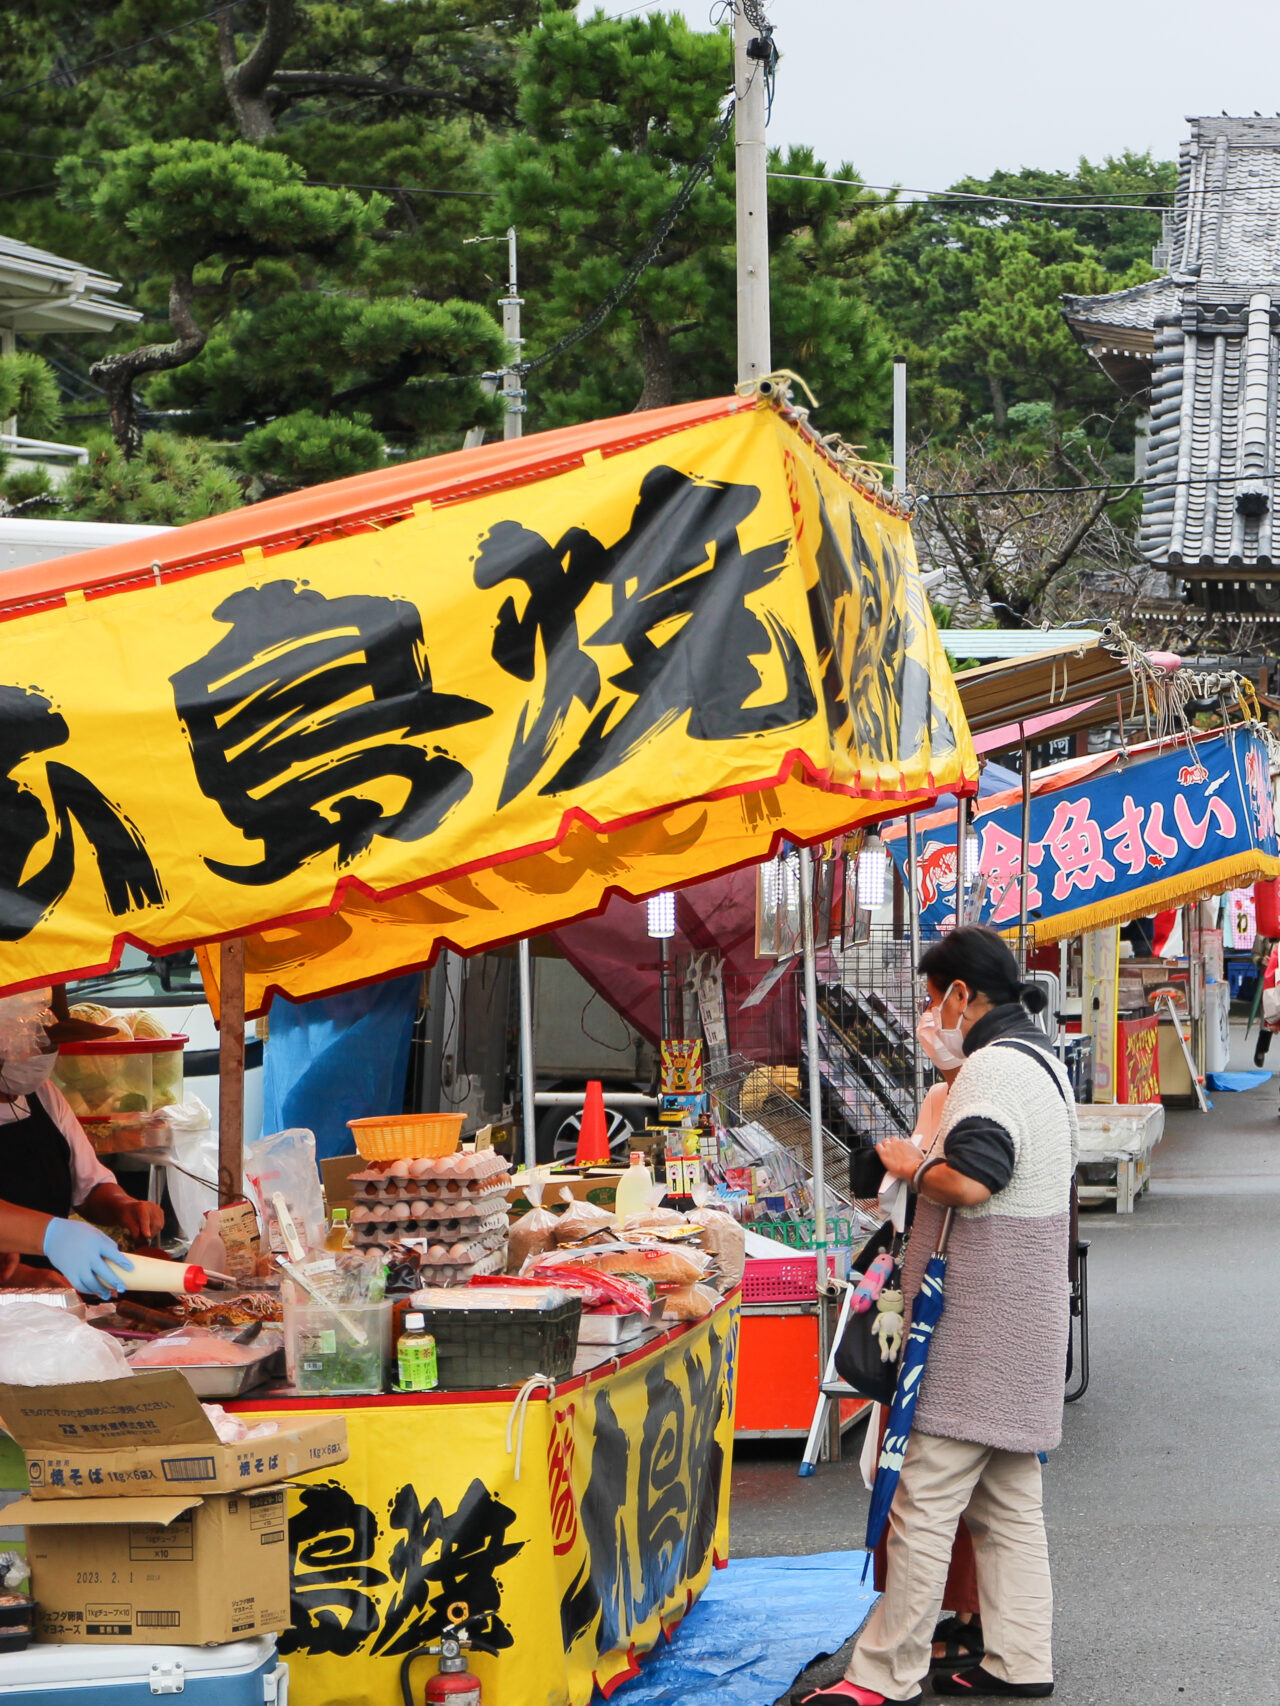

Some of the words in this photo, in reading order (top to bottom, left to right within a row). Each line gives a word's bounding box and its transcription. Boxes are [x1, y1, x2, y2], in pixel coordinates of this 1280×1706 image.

[978, 792, 1237, 924] 金魚すくい
[51, 1467, 104, 1487] 焼そば
[76, 1572, 102, 1584] 2023.
